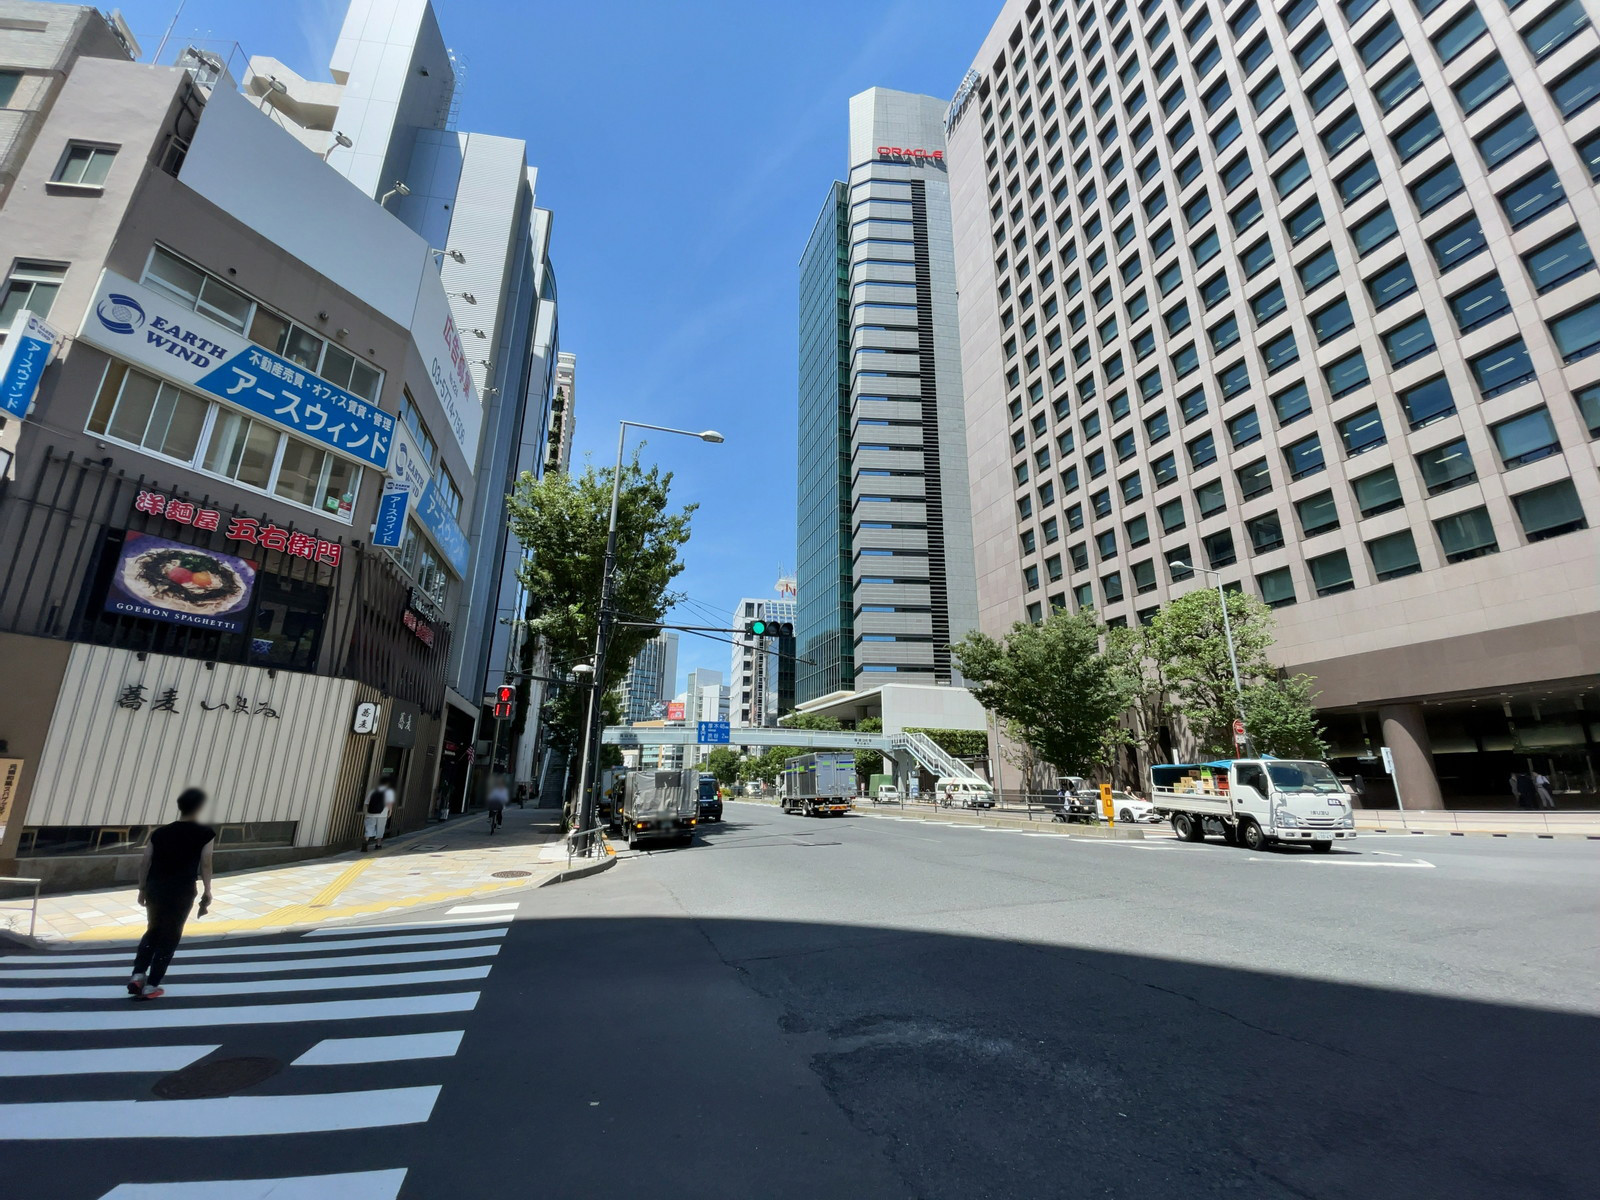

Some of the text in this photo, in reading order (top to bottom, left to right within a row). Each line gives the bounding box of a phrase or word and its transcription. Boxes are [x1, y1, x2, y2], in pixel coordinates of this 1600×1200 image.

[877, 146, 943, 158] ORACLE
[147, 330, 210, 369] WIND
[149, 316, 228, 360] EARTH
[7, 340, 41, 409] アースウィンド
[226, 366, 388, 459] アースウィンド
[408, 458, 424, 489] EARTH
[383, 495, 401, 544] アースウィンド
[225, 517, 343, 567] 五右衛門
[116, 602, 236, 630] GOEMON SPAGHETTI
[117, 684, 180, 715] 蕎麦
[357, 707, 371, 730] 蕎麦
